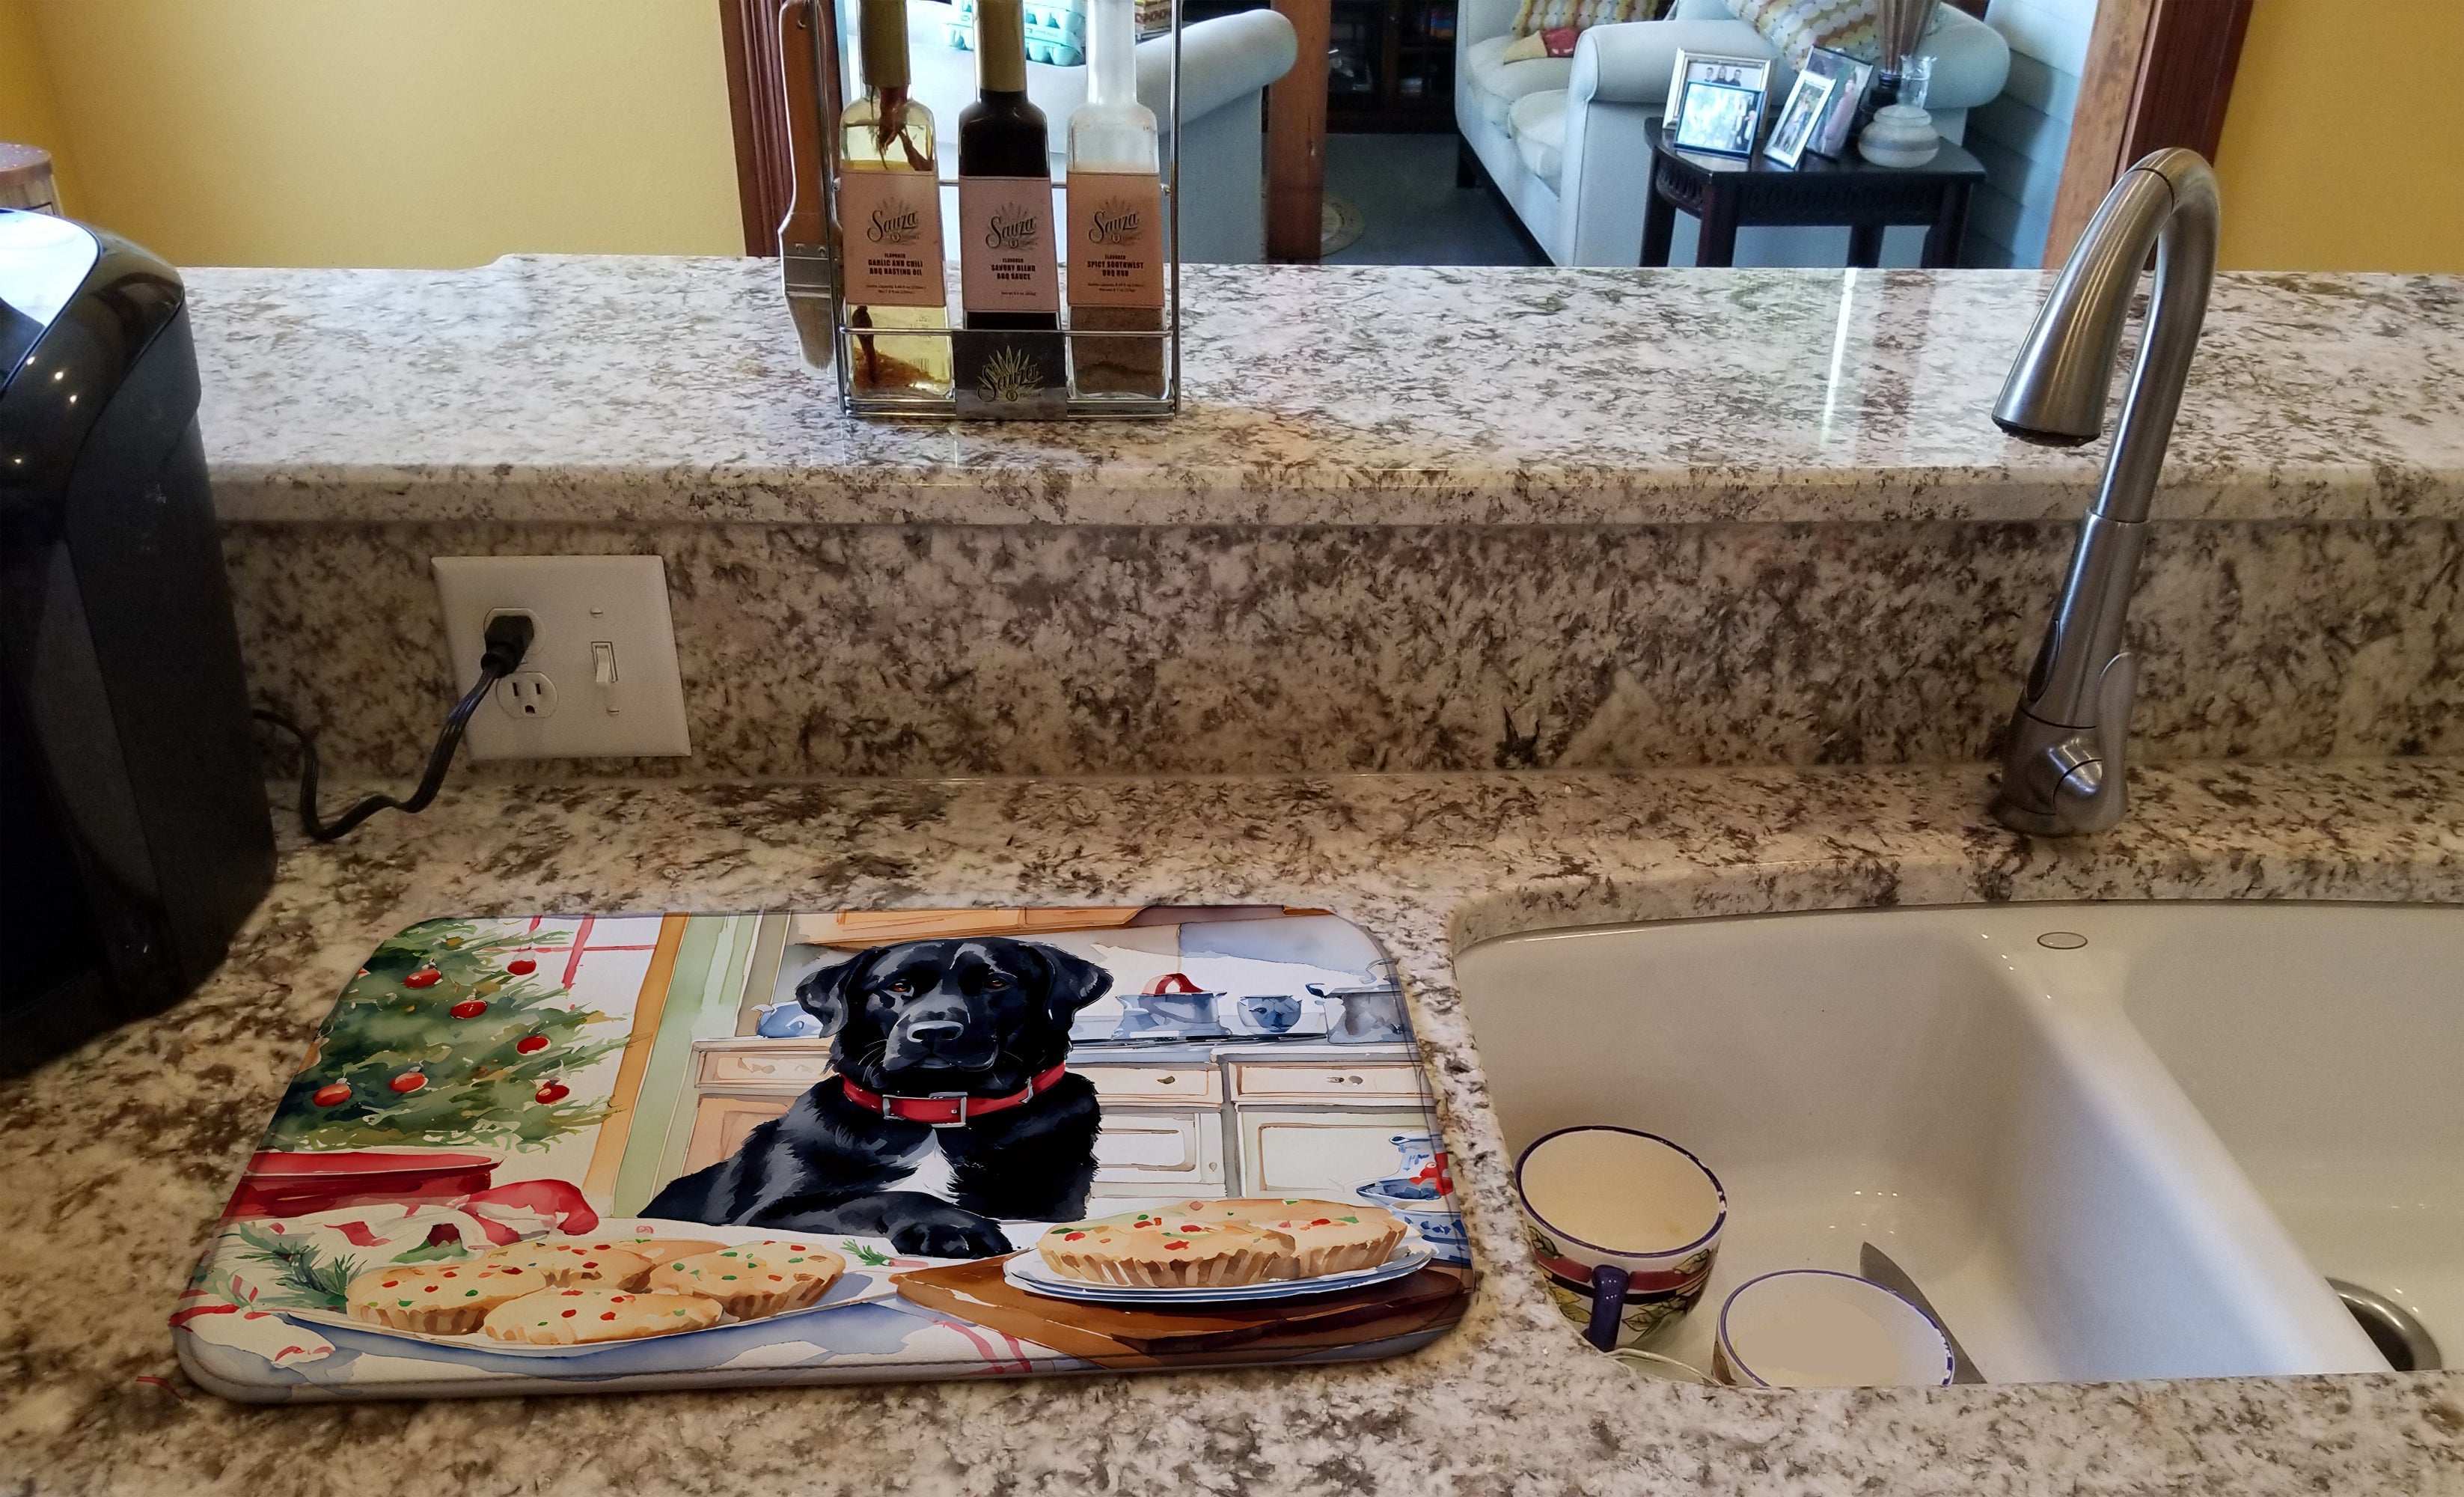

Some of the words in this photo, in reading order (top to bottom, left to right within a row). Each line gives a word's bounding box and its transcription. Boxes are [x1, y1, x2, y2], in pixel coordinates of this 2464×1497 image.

[867, 210, 918, 243] Sauza
[985, 216, 1037, 248] Sauza
[1089, 210, 1140, 243] Sauza
[1103, 269, 1115, 277] BBQ
[977, 365, 1039, 403] Sauza
